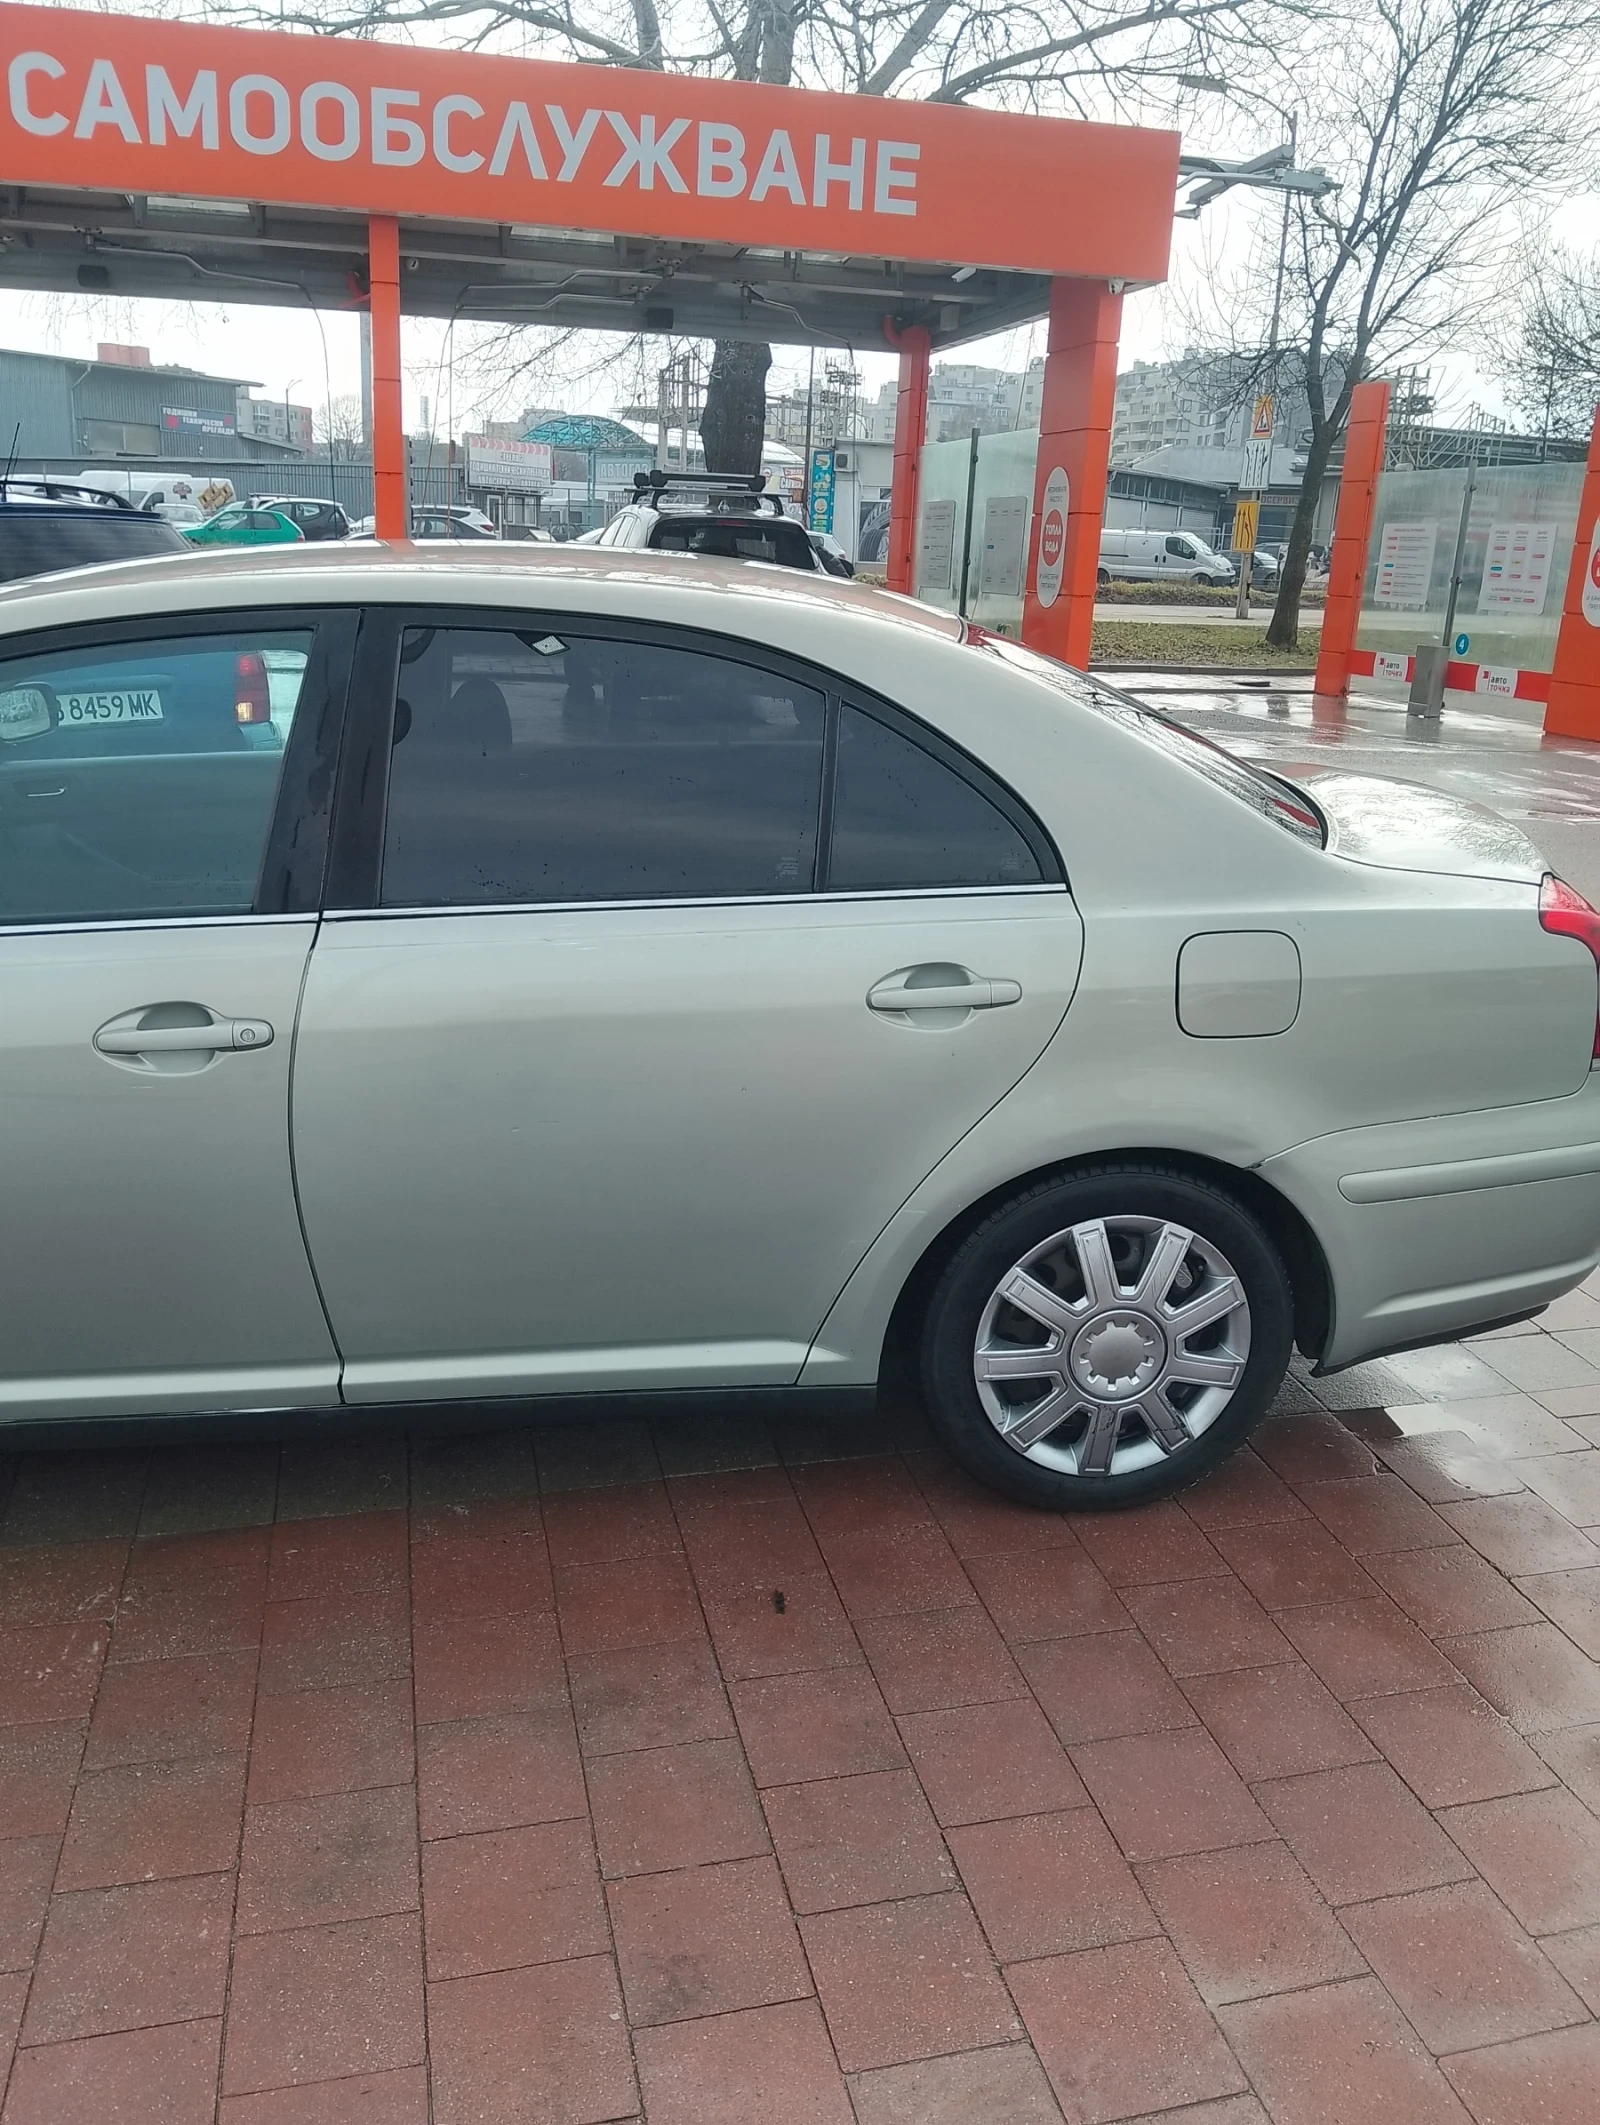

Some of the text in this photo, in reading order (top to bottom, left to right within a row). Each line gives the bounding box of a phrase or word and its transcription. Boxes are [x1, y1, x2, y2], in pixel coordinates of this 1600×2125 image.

[8, 51, 921, 216] САМООБСЛУЖВАНЕ
[1045, 541, 1059, 553] ВОДА
[1459, 639, 1465, 650] 4
[1386, 662, 1399, 670] авто
[1385, 669, 1402, 677] точка
[1490, 676, 1507, 684] авто
[1490, 684, 1510, 693] точка
[69, 693, 124, 721] 8459
